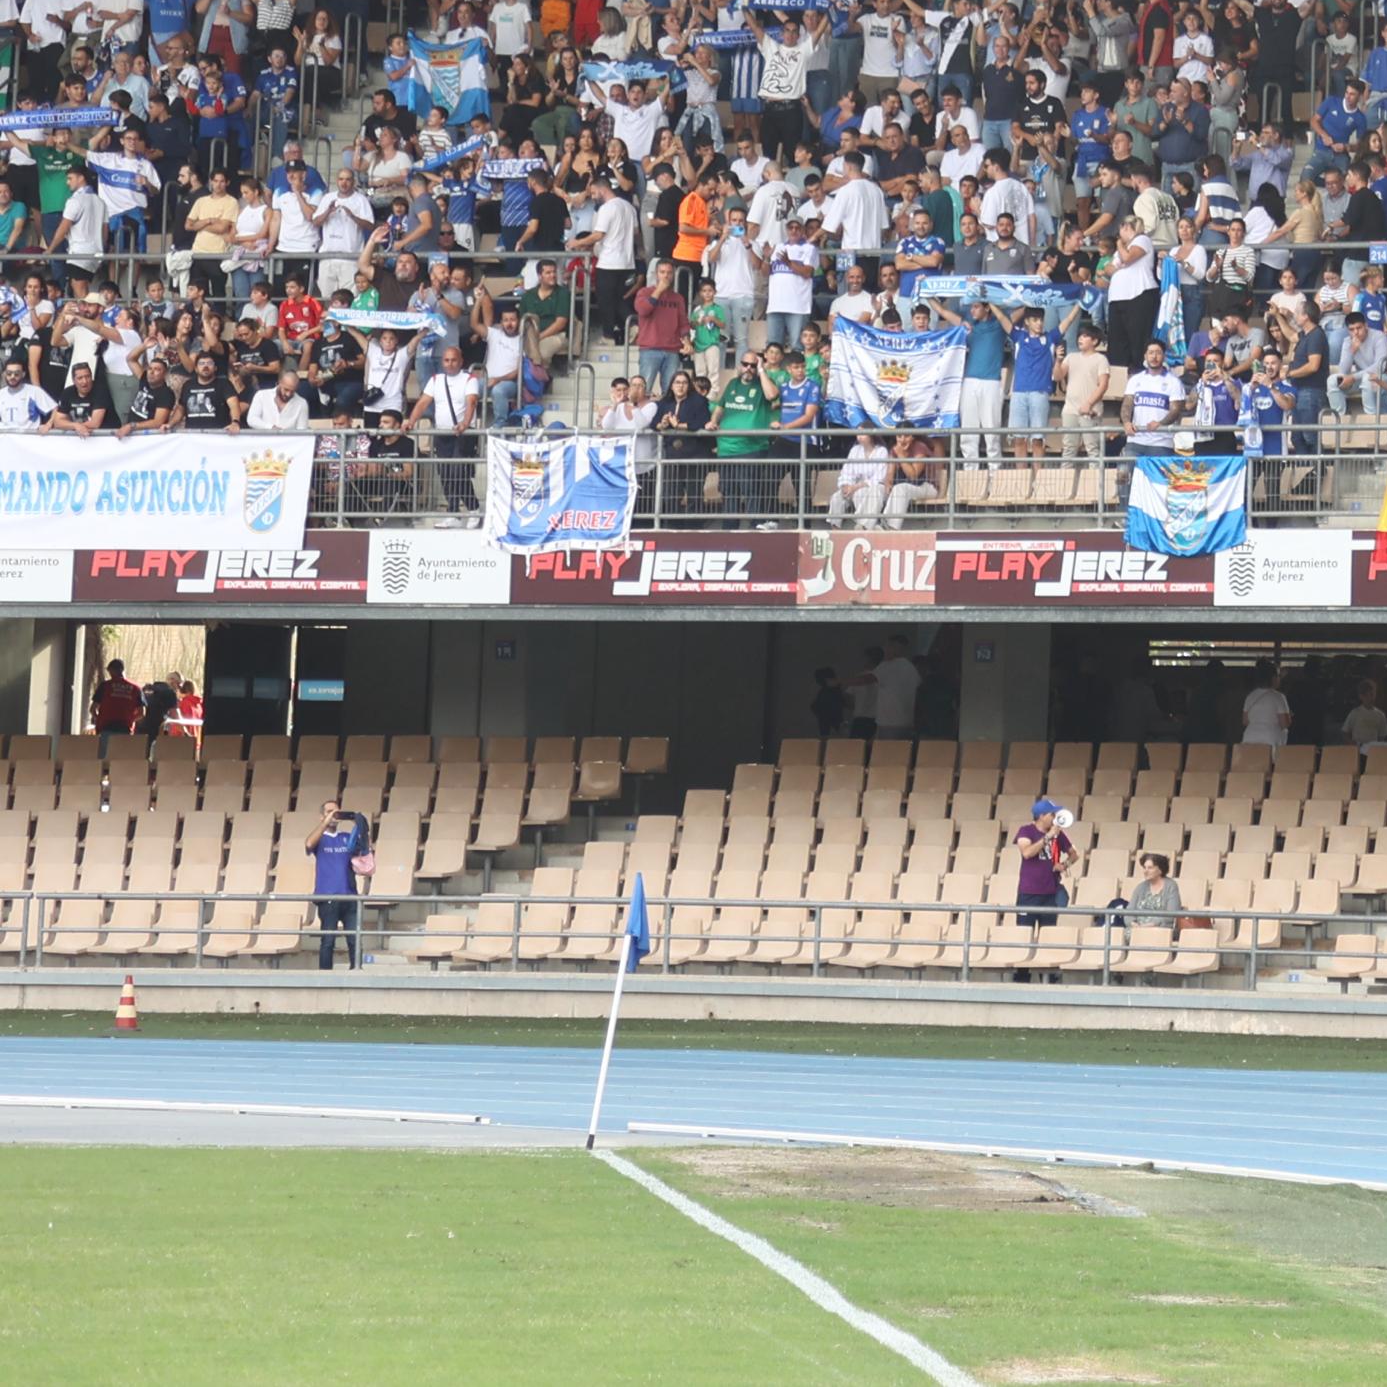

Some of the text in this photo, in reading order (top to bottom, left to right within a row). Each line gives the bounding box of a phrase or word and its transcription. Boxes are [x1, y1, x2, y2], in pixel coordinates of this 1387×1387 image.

[837, 258, 854, 269] 214
[1371, 251, 1387, 262] 214
[96, 457, 231, 516] ASUNCIÓN
[546, 509, 617, 532] XEREZ
[91, 550, 321, 593] PLAY JEREZ
[417, 557, 497, 570] Ayuntamiento
[529, 541, 752, 596] PLAY JEREZ
[841, 538, 937, 591] Cruz
[952, 541, 1168, 597] PLAY JEREZ
[1262, 558, 1339, 570] Ayuntamiento
[417, 569, 462, 583] de Jerez
[1262, 570, 1305, 583] de Jerez
